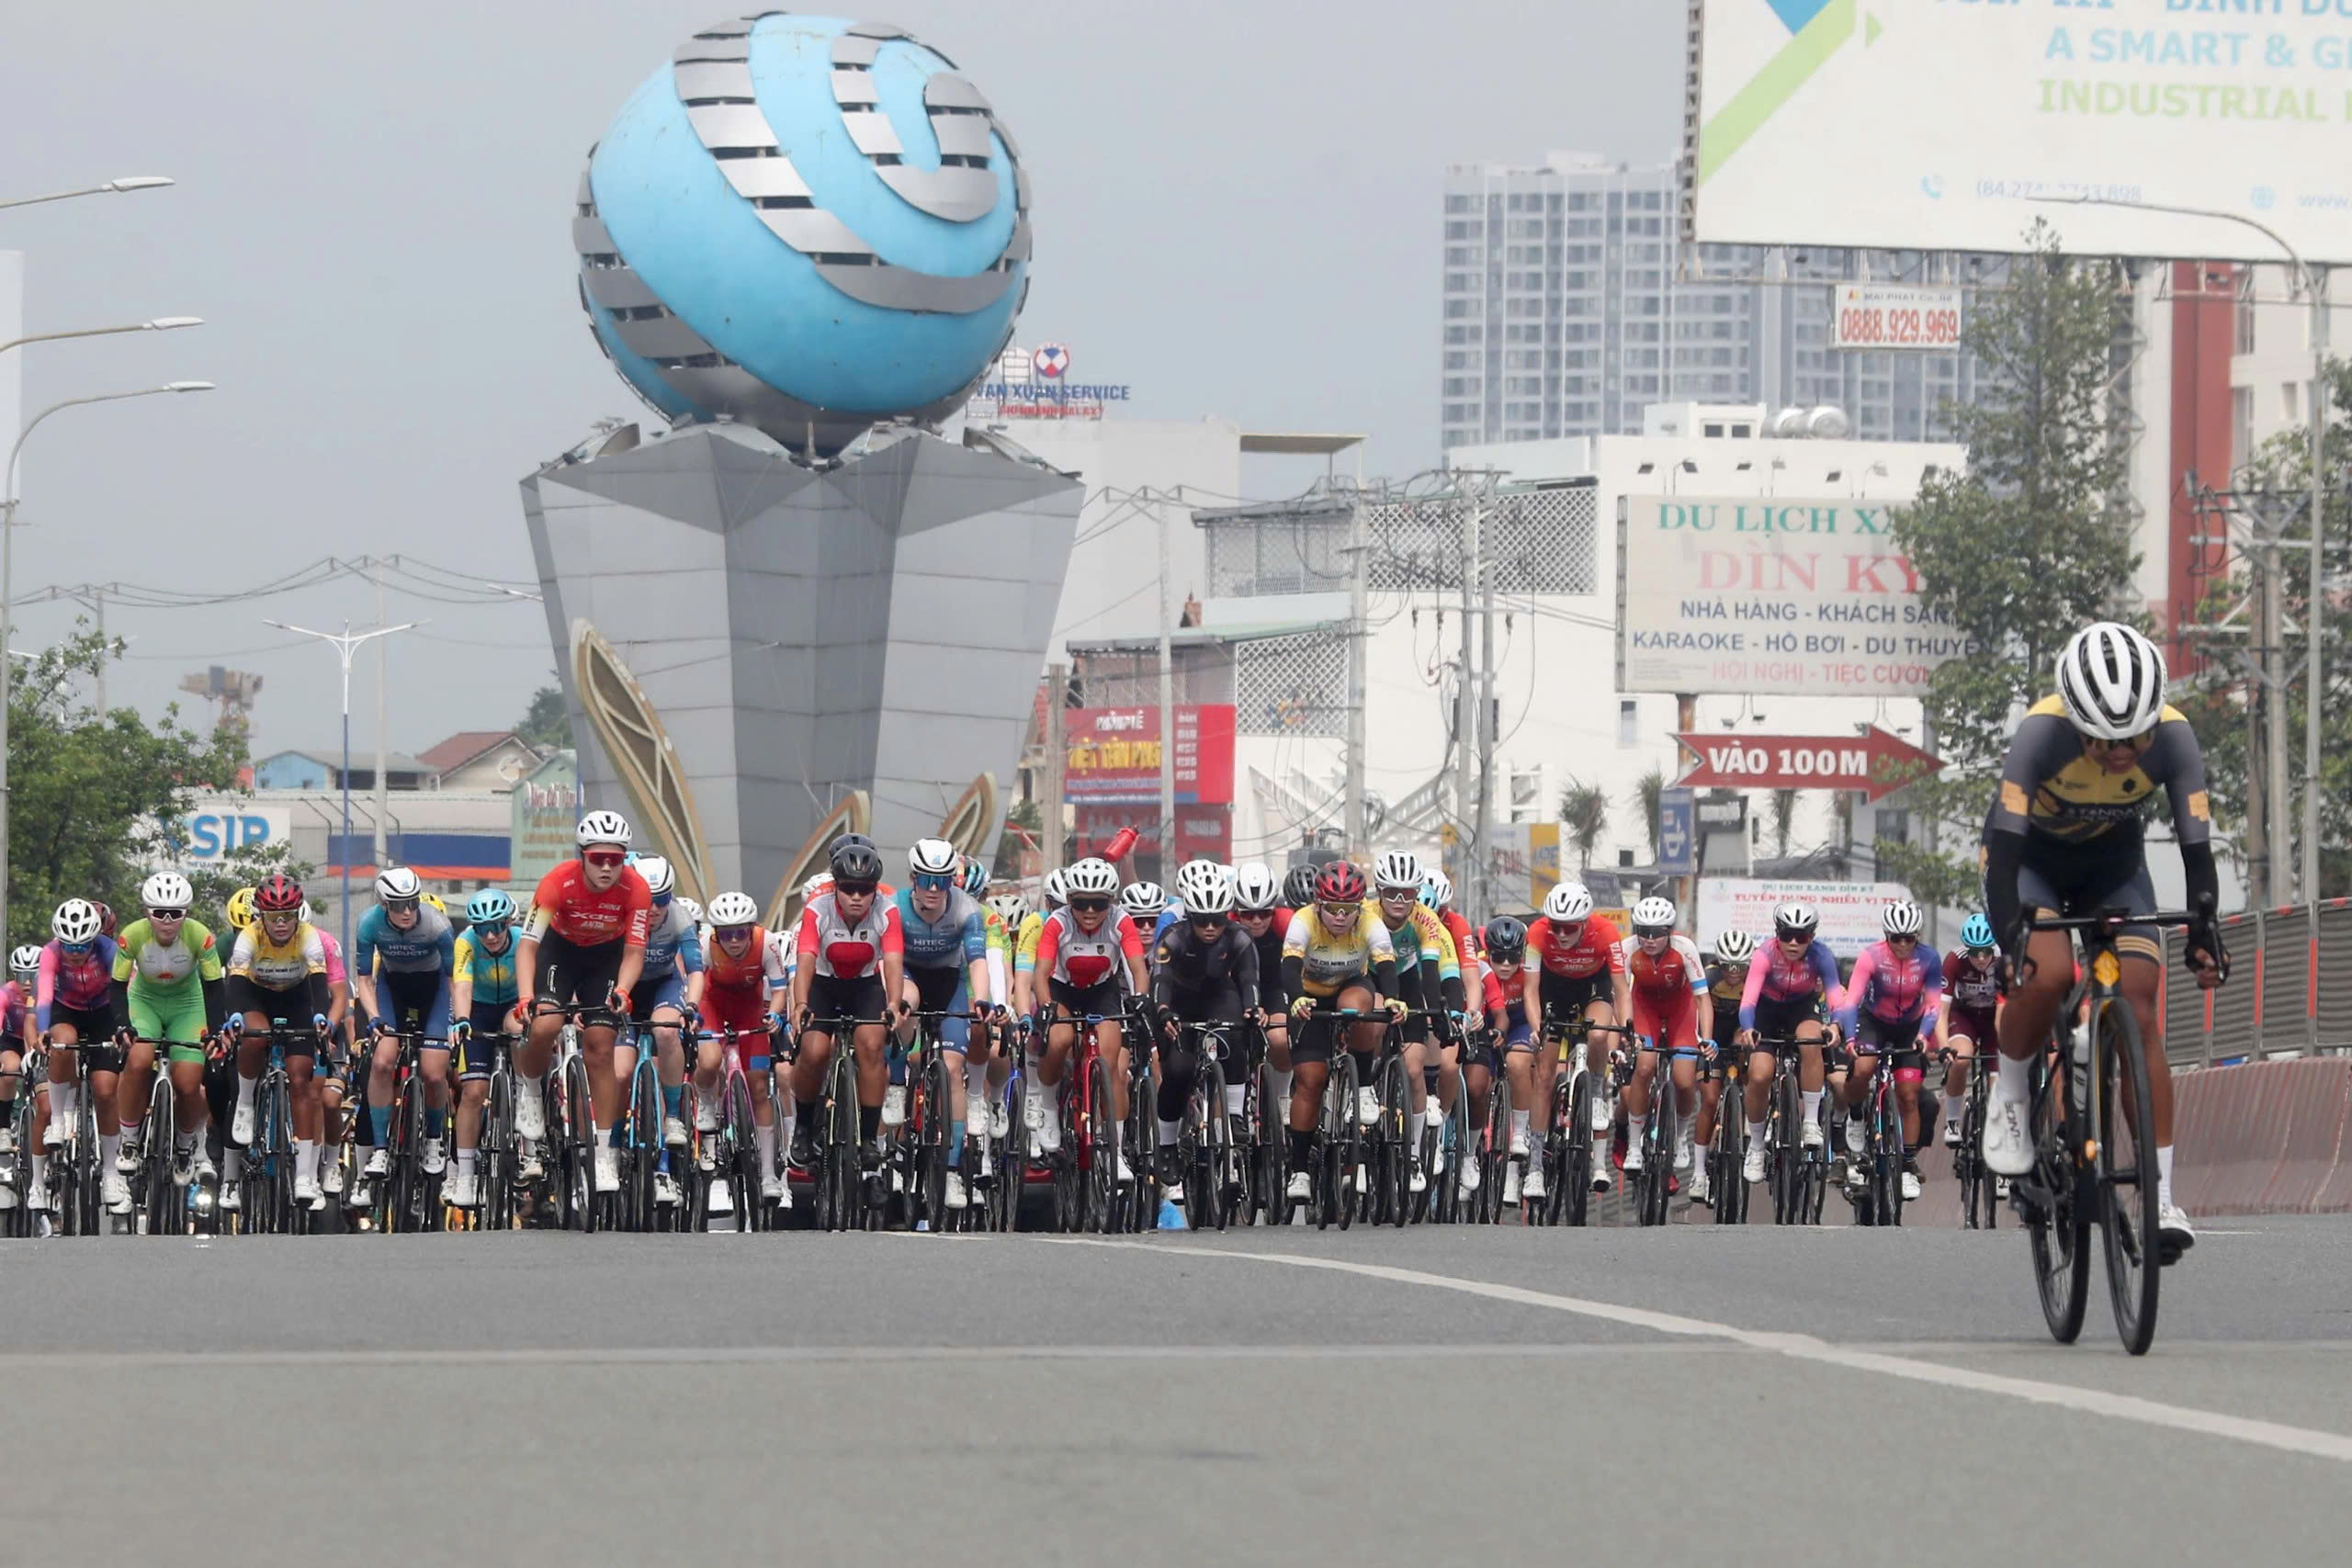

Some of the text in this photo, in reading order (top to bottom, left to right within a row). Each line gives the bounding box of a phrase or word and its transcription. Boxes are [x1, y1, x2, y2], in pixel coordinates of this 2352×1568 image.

[2045, 27, 2352, 69] A SMART & G
[2038, 78, 2328, 122] INDUSTRIAL
[1840, 308, 1958, 344] 0888.929.969
[1061, 385, 1131, 400] SERVICE
[1657, 503, 1719, 531] DU
[1736, 504, 1838, 538] LỊCH
[1696, 540, 1820, 592] DÌN
[1680, 597, 1727, 619] NHÀ
[1735, 597, 1798, 622] HÀNG
[1818, 598, 1895, 623] KHÁCH
[1634, 631, 1744, 652] KARAOKE
[1866, 637, 1896, 654] DU
[598, 902, 621, 911] CHINA
[581, 920, 605, 929] ANTA
[631, 909, 648, 940] ANTA
[913, 938, 946, 946] HITEC
[1463, 934, 1478, 963] ANTA
[1610, 941, 1624, 967] ANTA
